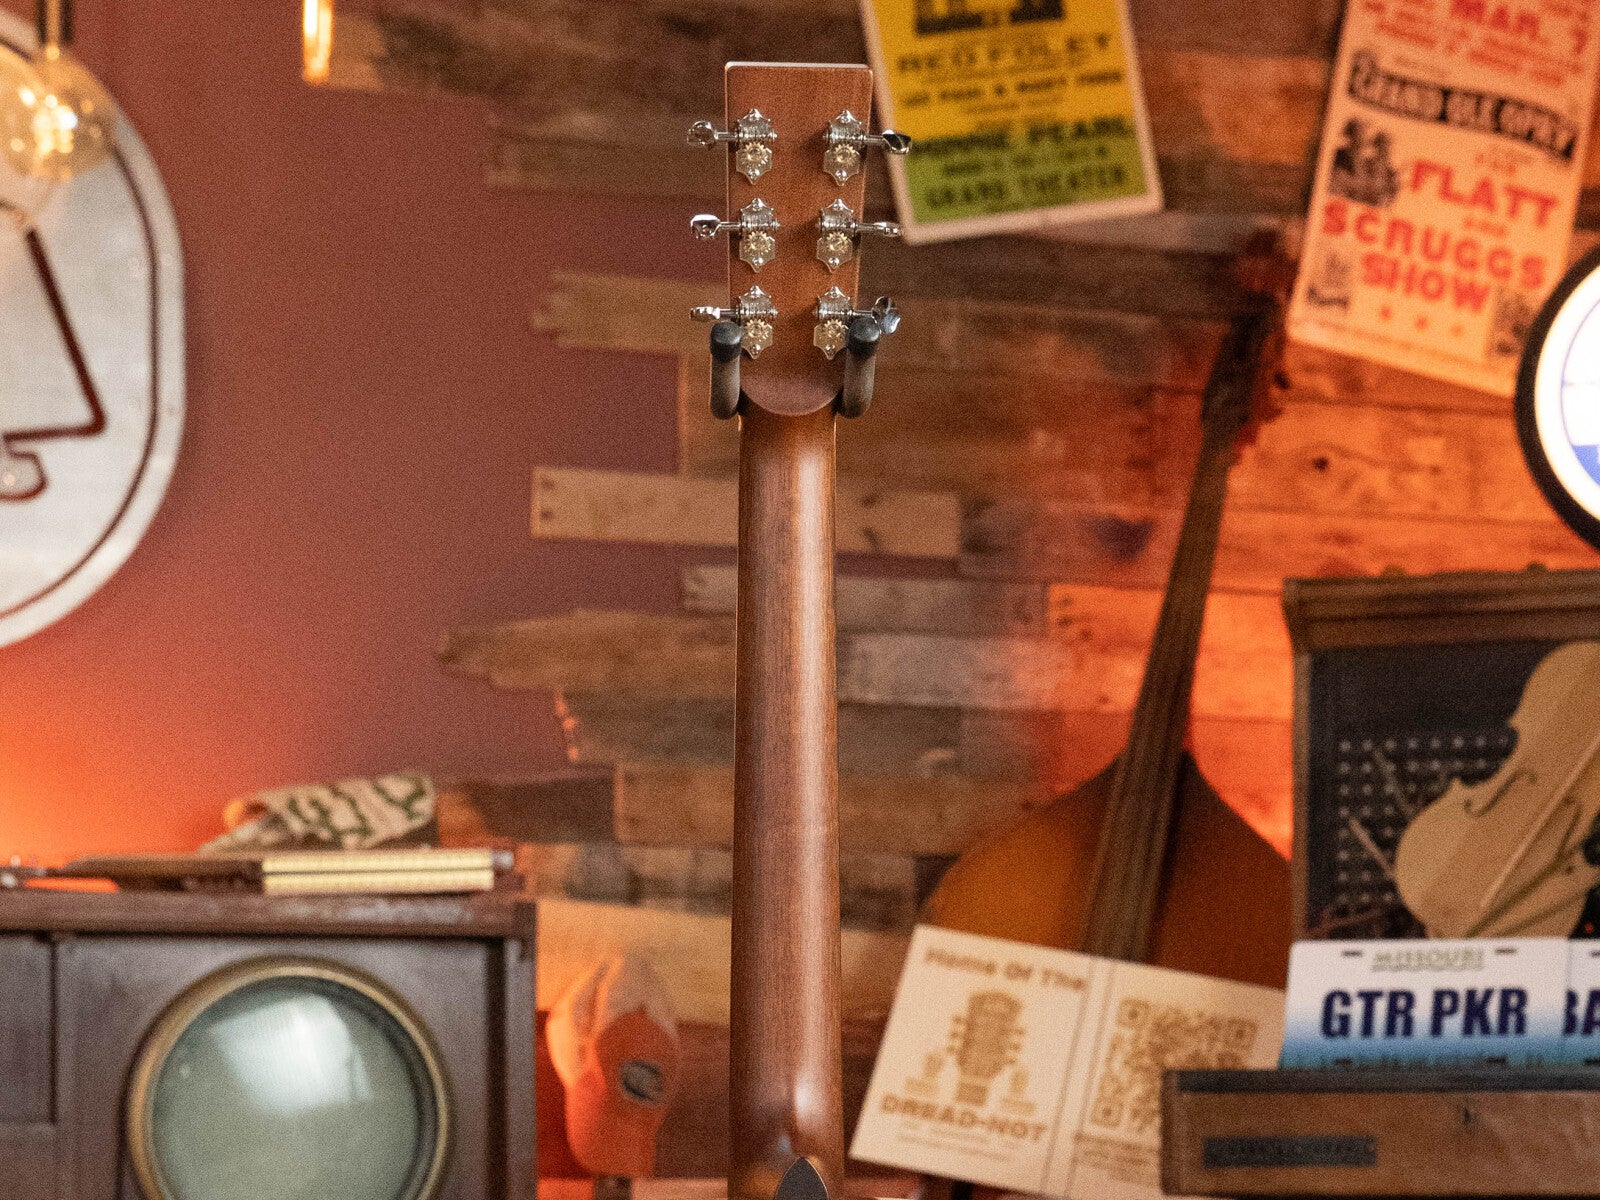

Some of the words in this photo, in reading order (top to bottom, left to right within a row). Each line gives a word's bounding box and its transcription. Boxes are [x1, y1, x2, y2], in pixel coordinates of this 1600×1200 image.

[1409, 158, 1559, 229] FLATT
[1322, 199, 1547, 291] SCRUGGS
[1361, 251, 1490, 315] SHOW
[1371, 947, 1486, 973] MISSOURI
[1320, 988, 1416, 1039] GTR
[1429, 986, 1529, 1038] PKR
[880, 1093, 1046, 1144] DREAD-NOT
